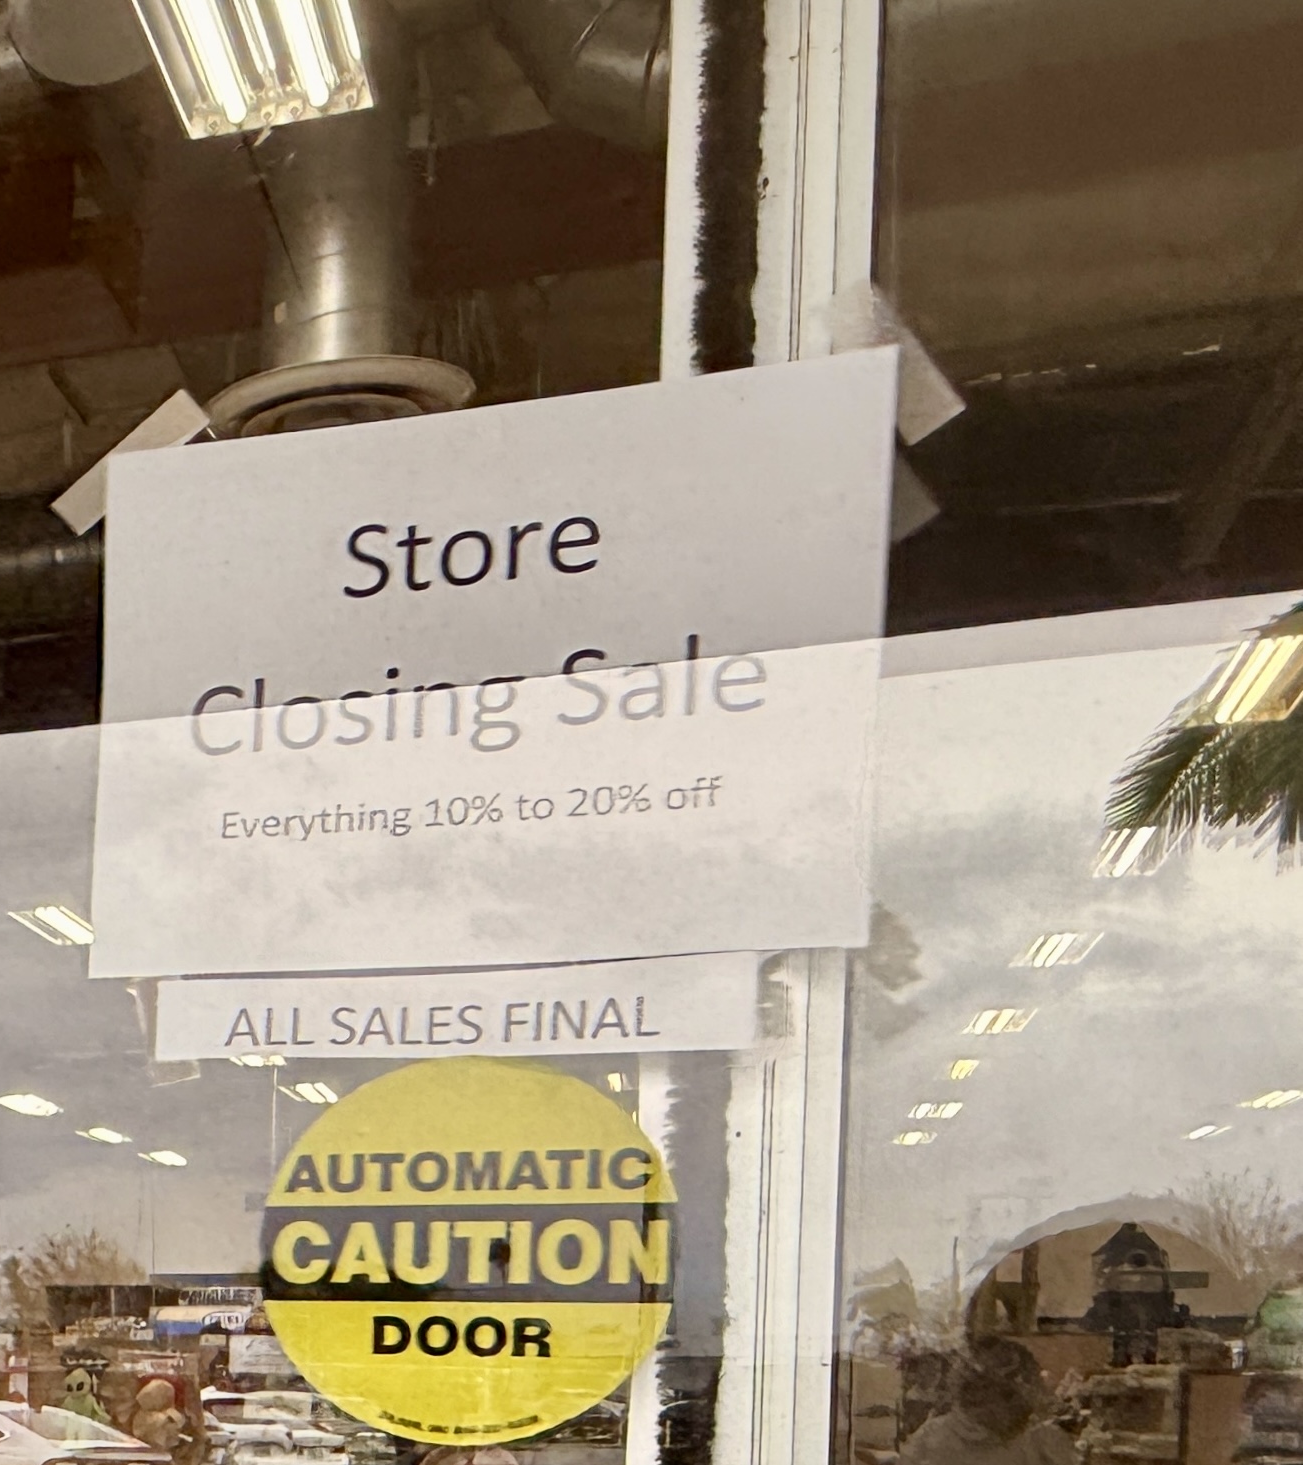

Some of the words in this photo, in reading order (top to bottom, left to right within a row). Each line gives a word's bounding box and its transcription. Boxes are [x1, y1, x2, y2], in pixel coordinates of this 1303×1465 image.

[342, 516, 601, 598] Store
[192, 667, 524, 755] Closing
[557, 633, 768, 726] Sale
[221, 803, 412, 842] Everything
[424, 792, 504, 828] 10%
[516, 790, 553, 820] to
[567, 782, 652, 817] 20%
[666, 775, 724, 810] off
[224, 1006, 315, 1047] ALL
[329, 1004, 485, 1046] SALES
[500, 995, 662, 1043] FINAL
[284, 1147, 654, 1194] AUTOMATIC
[271, 1217, 672, 1286] CAUTION
[371, 1314, 553, 1358] DOOR
